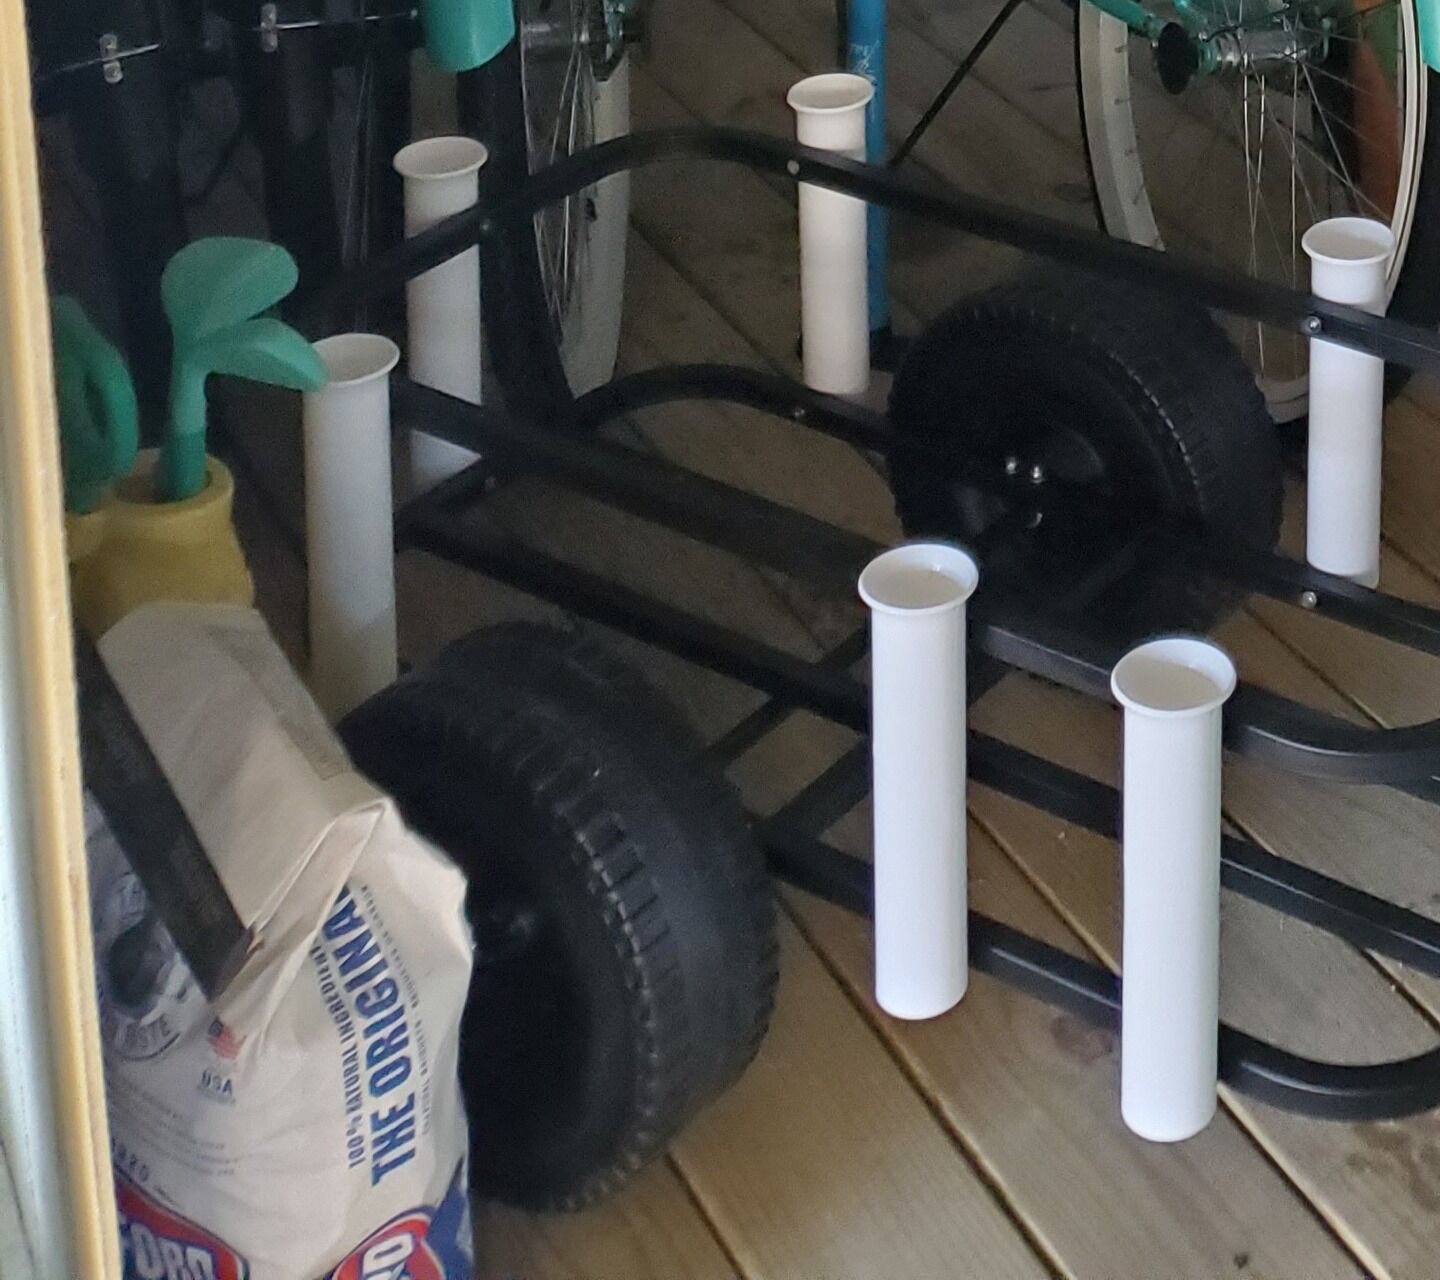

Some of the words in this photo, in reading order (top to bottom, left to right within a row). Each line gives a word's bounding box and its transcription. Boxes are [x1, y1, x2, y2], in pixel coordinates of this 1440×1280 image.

[309, 944, 357, 1044] INGREDIENT
[201, 1068, 234, 1096] USA
[342, 1042, 364, 1115] NATURAL
[371, 1092, 416, 1187] THE
